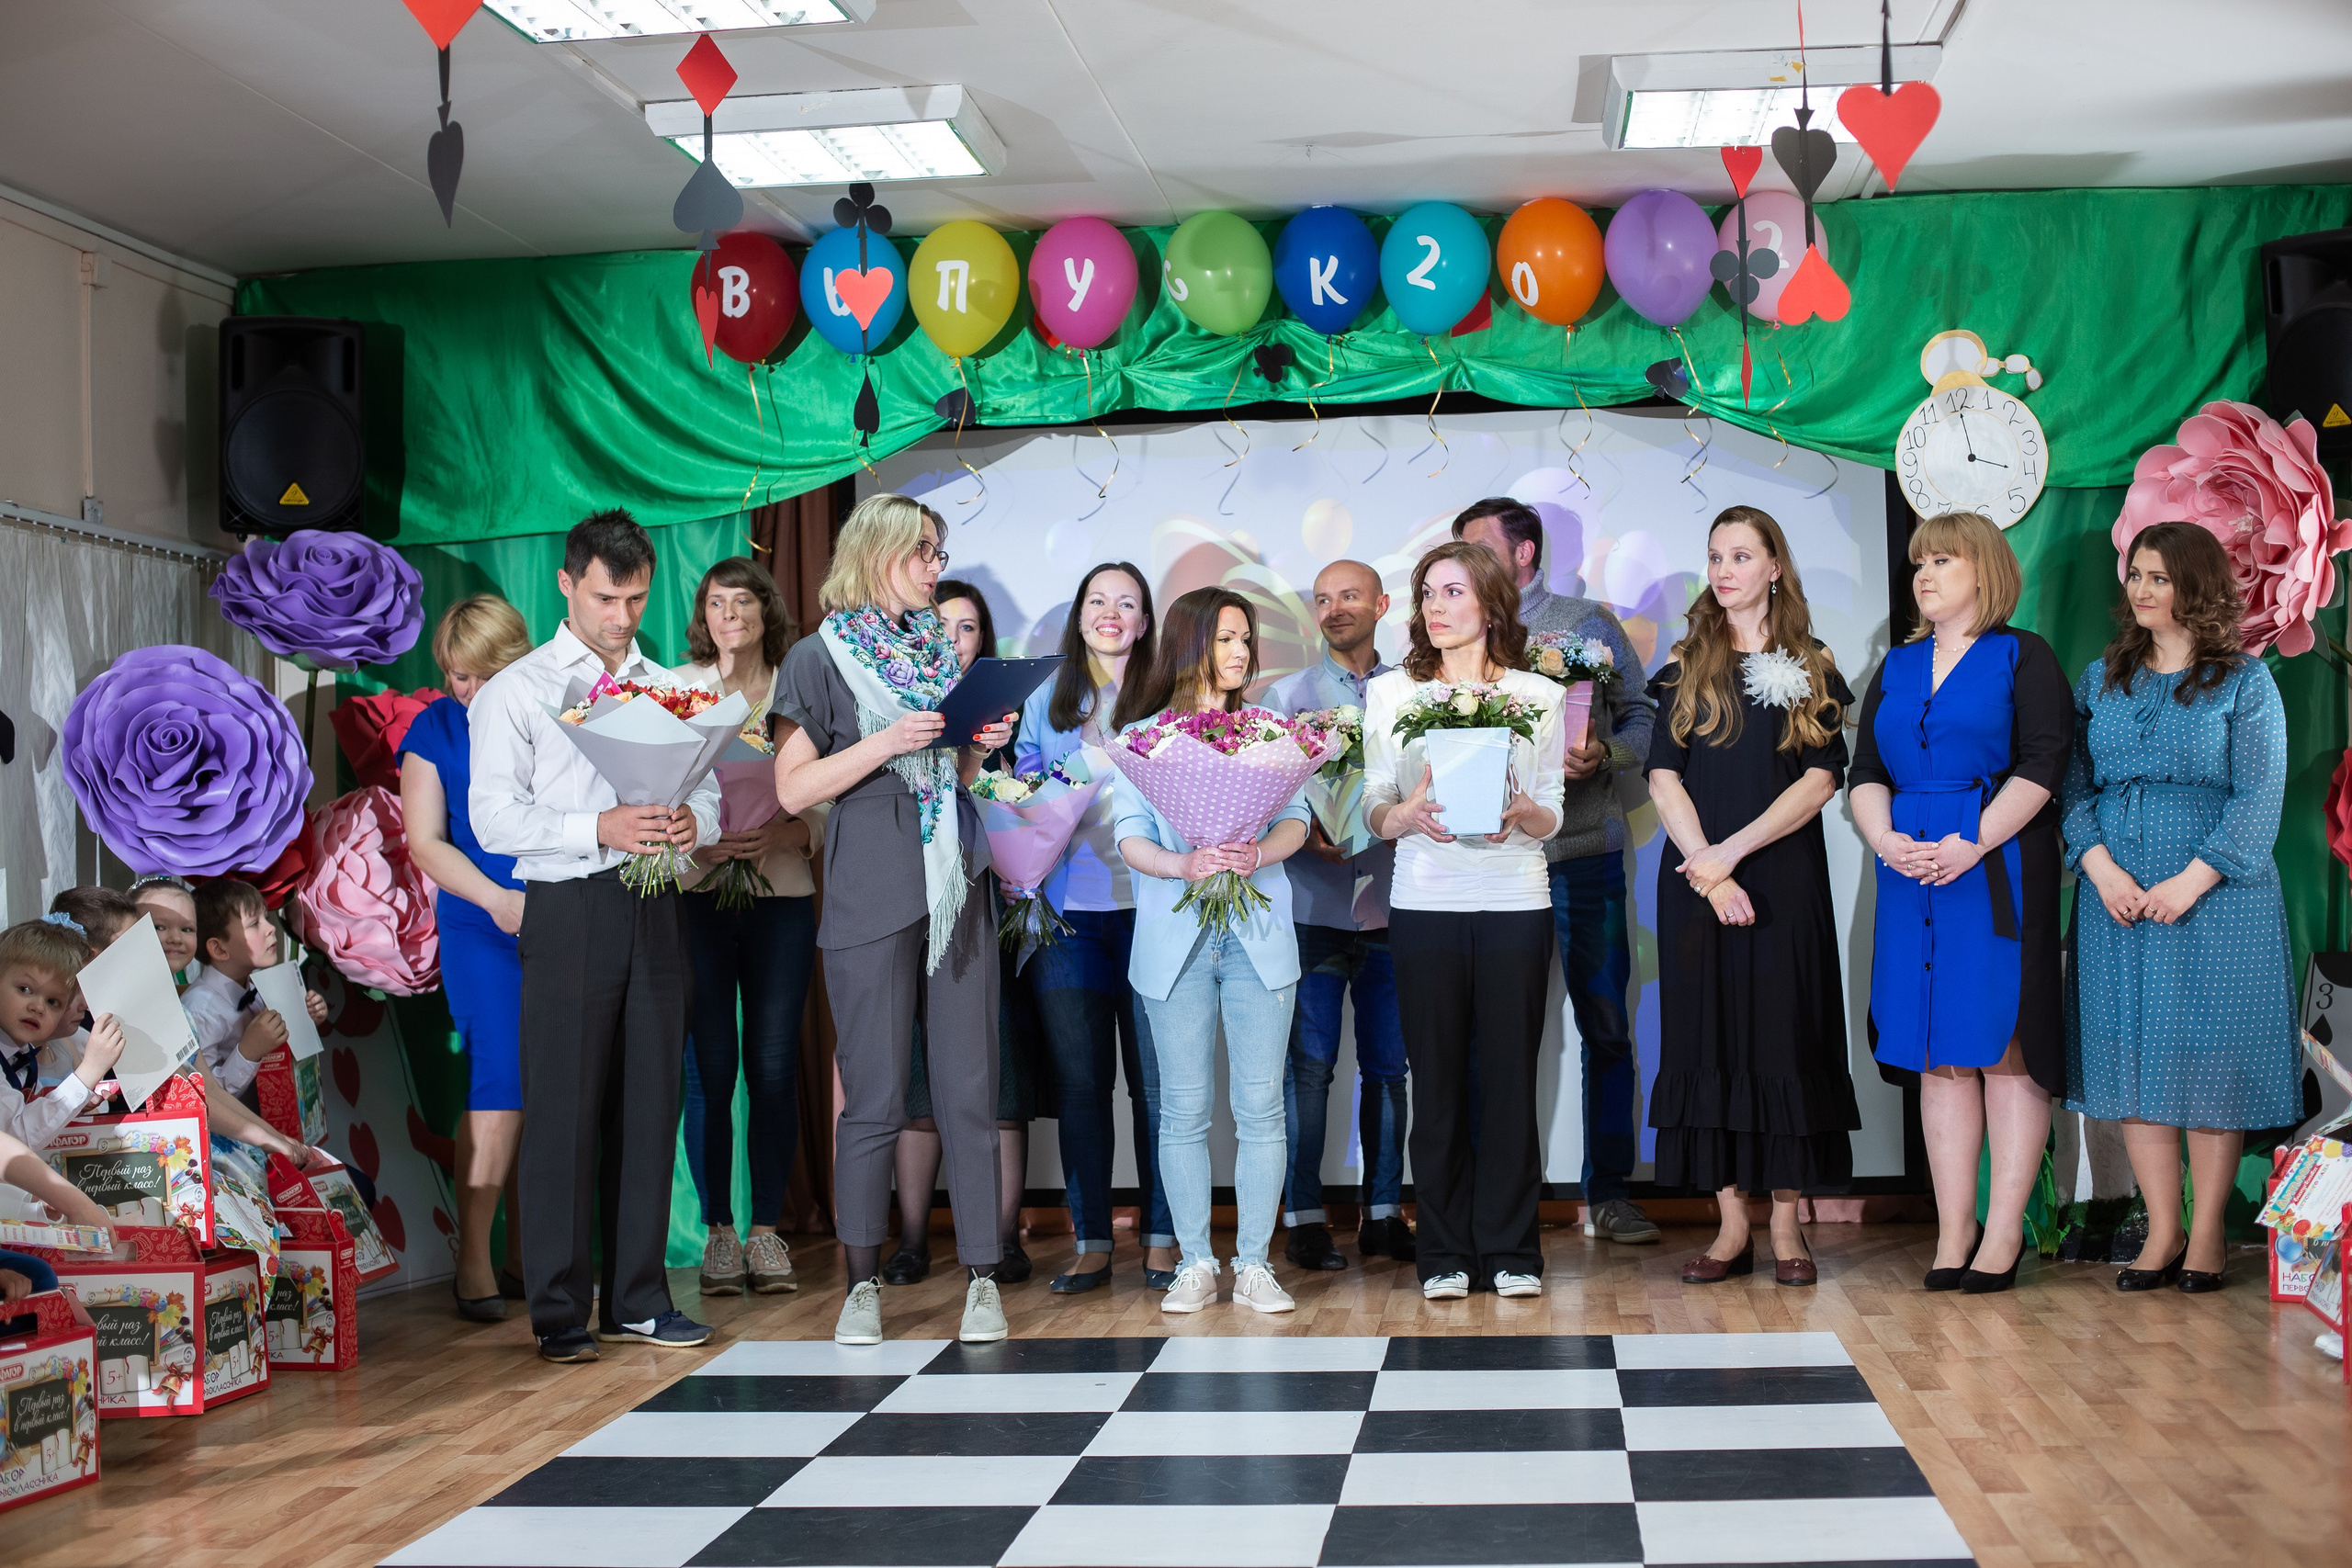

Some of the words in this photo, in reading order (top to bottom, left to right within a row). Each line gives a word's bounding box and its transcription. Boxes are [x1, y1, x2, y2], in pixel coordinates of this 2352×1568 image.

[1946, 388, 1974, 413] 12
[1982, 390, 1993, 411] 1
[1918, 403, 1939, 426] 11
[2003, 400, 2026, 425] 2
[1903, 426, 1927, 450] 10
[2021, 430, 2038, 456] 3
[1902, 452, 1918, 478] 9
[2023, 459, 2038, 485] 4
[1909, 479, 1930, 509] 8
[2007, 487, 2026, 514] 5
[2315, 982, 2334, 1010] 3
[50, 1135, 85, 1148] ФАГОР
[79, 1160, 131, 1179] Первый
[132, 1164, 153, 1179] раз
[84, 1175, 121, 1196] первый
[124, 1176, 162, 1190] класс!
[2282, 1272, 2315, 1282] НАБО
[119, 1320, 142, 1335] раз
[267, 1330, 279, 1343] 5+
[108, 1333, 150, 1347] класс!
[107, 1370, 122, 1385] 5+
[46, 1449, 56, 1464] 5+
[0, 1468, 25, 1484] АБОР
[0, 1472, 59, 1497] ВОКЛАССНИКА
